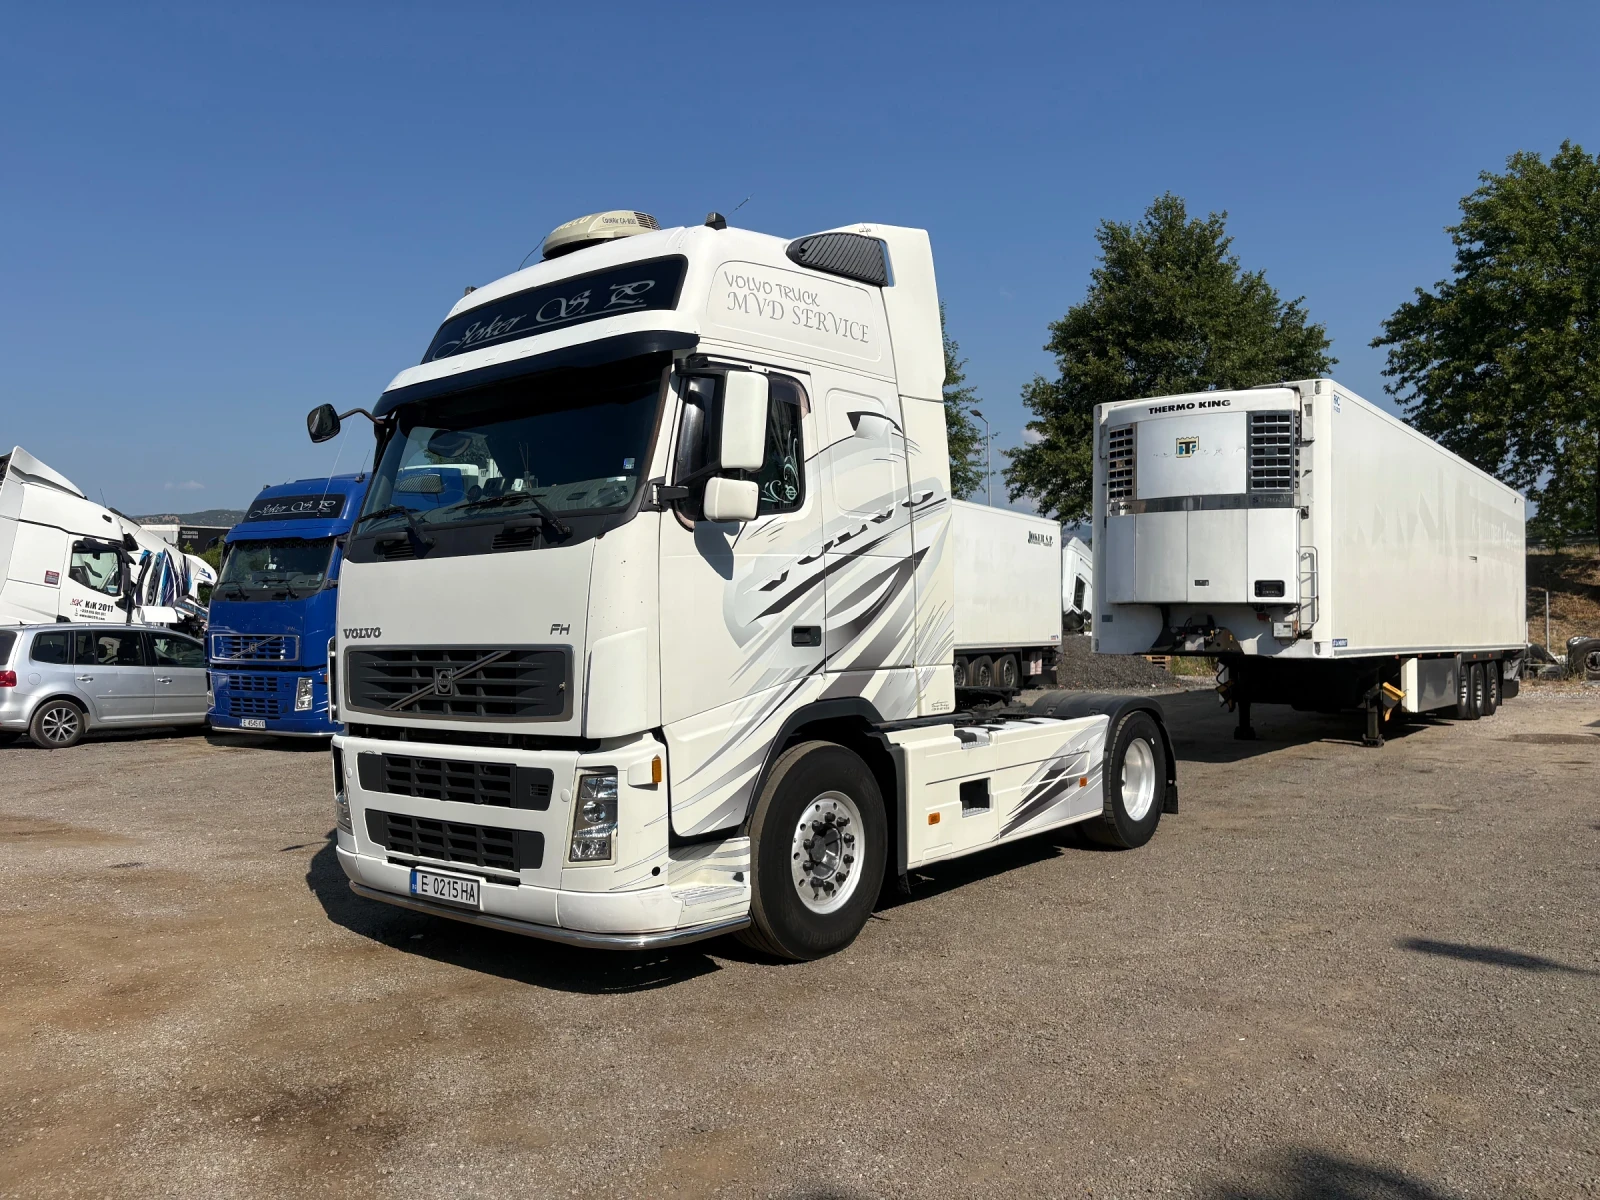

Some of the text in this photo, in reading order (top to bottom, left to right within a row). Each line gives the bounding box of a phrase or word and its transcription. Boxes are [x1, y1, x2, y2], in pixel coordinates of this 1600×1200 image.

[724, 270, 820, 308] VOLVO TRUCK
[726, 291, 870, 344] MVD SERVICE
[1148, 399, 1231, 415] THERMO KING
[97, 602, 114, 613] 2011
[343, 623, 571, 639] VOLVO FH
[421, 875, 429, 893] E
